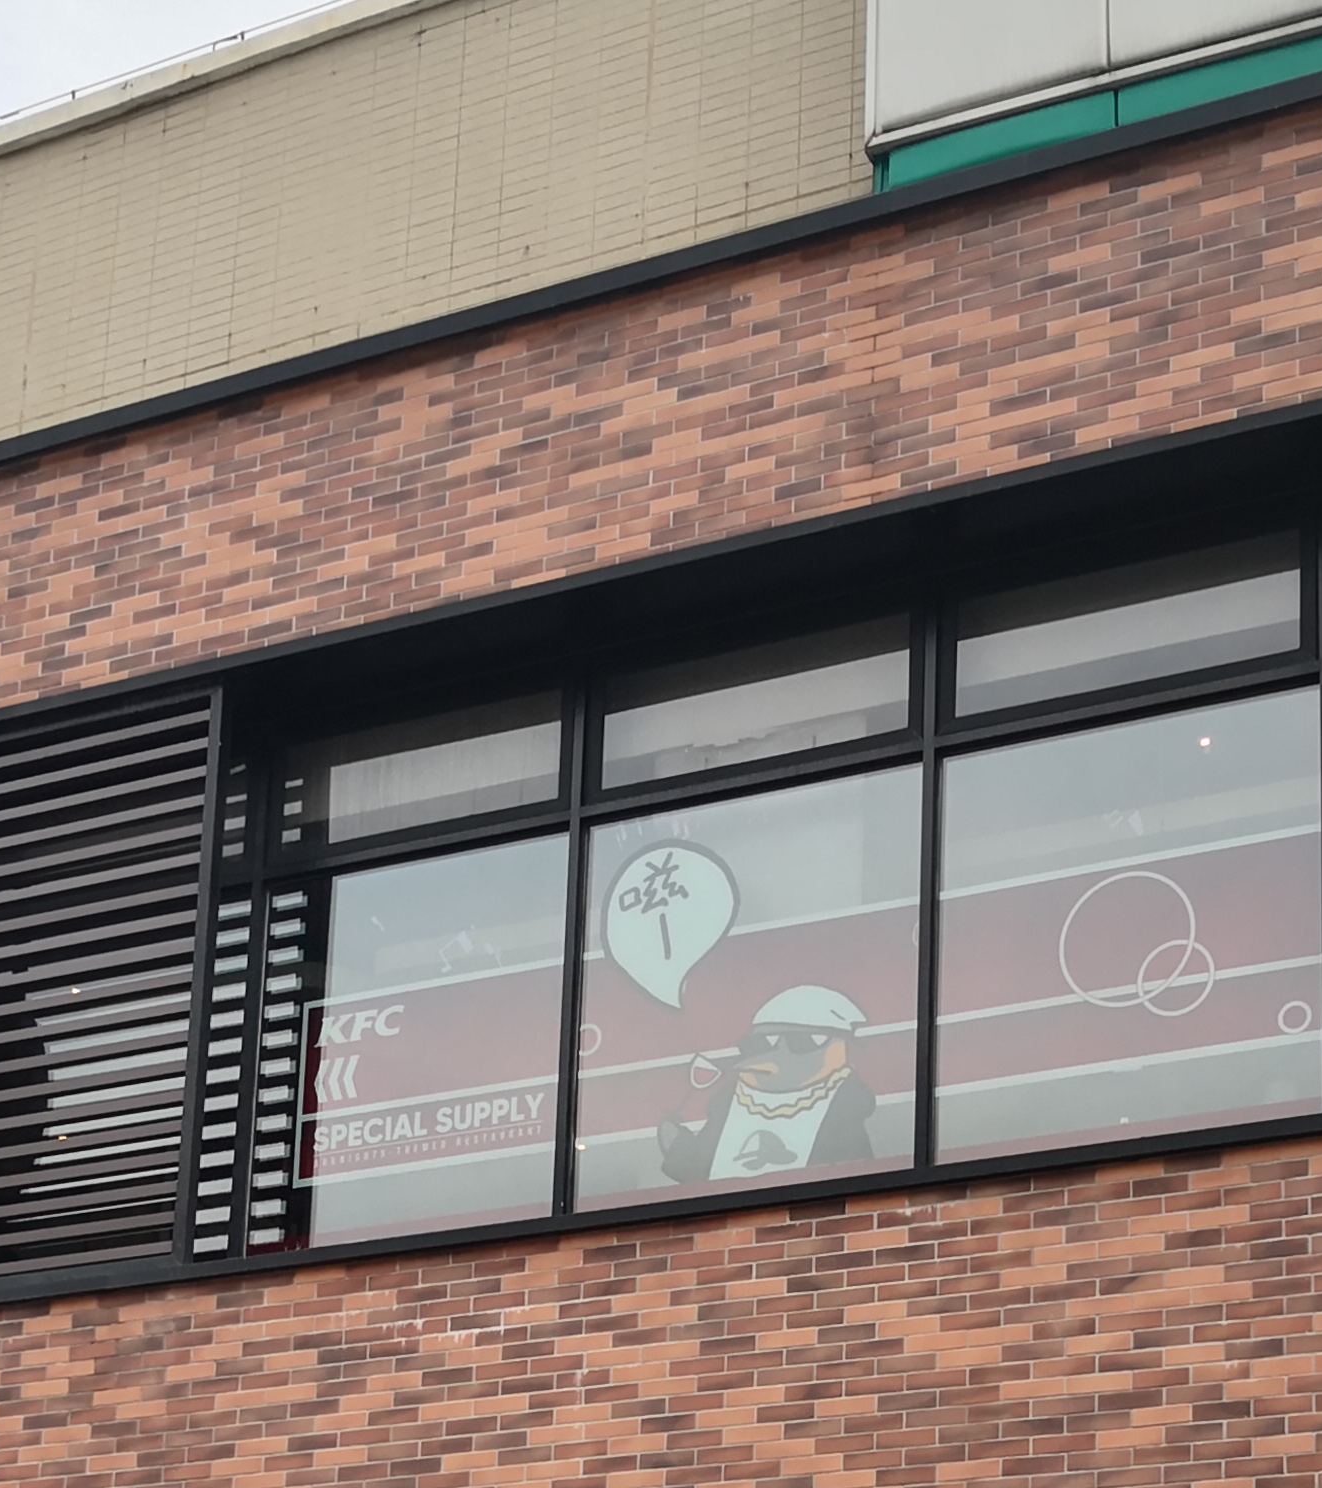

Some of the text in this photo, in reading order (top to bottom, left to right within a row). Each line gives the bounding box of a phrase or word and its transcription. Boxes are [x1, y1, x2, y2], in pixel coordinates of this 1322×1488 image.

[314, 1005, 405, 1049] KFC
[314, 1092, 545, 1153] SPECIAL SUPPLY
